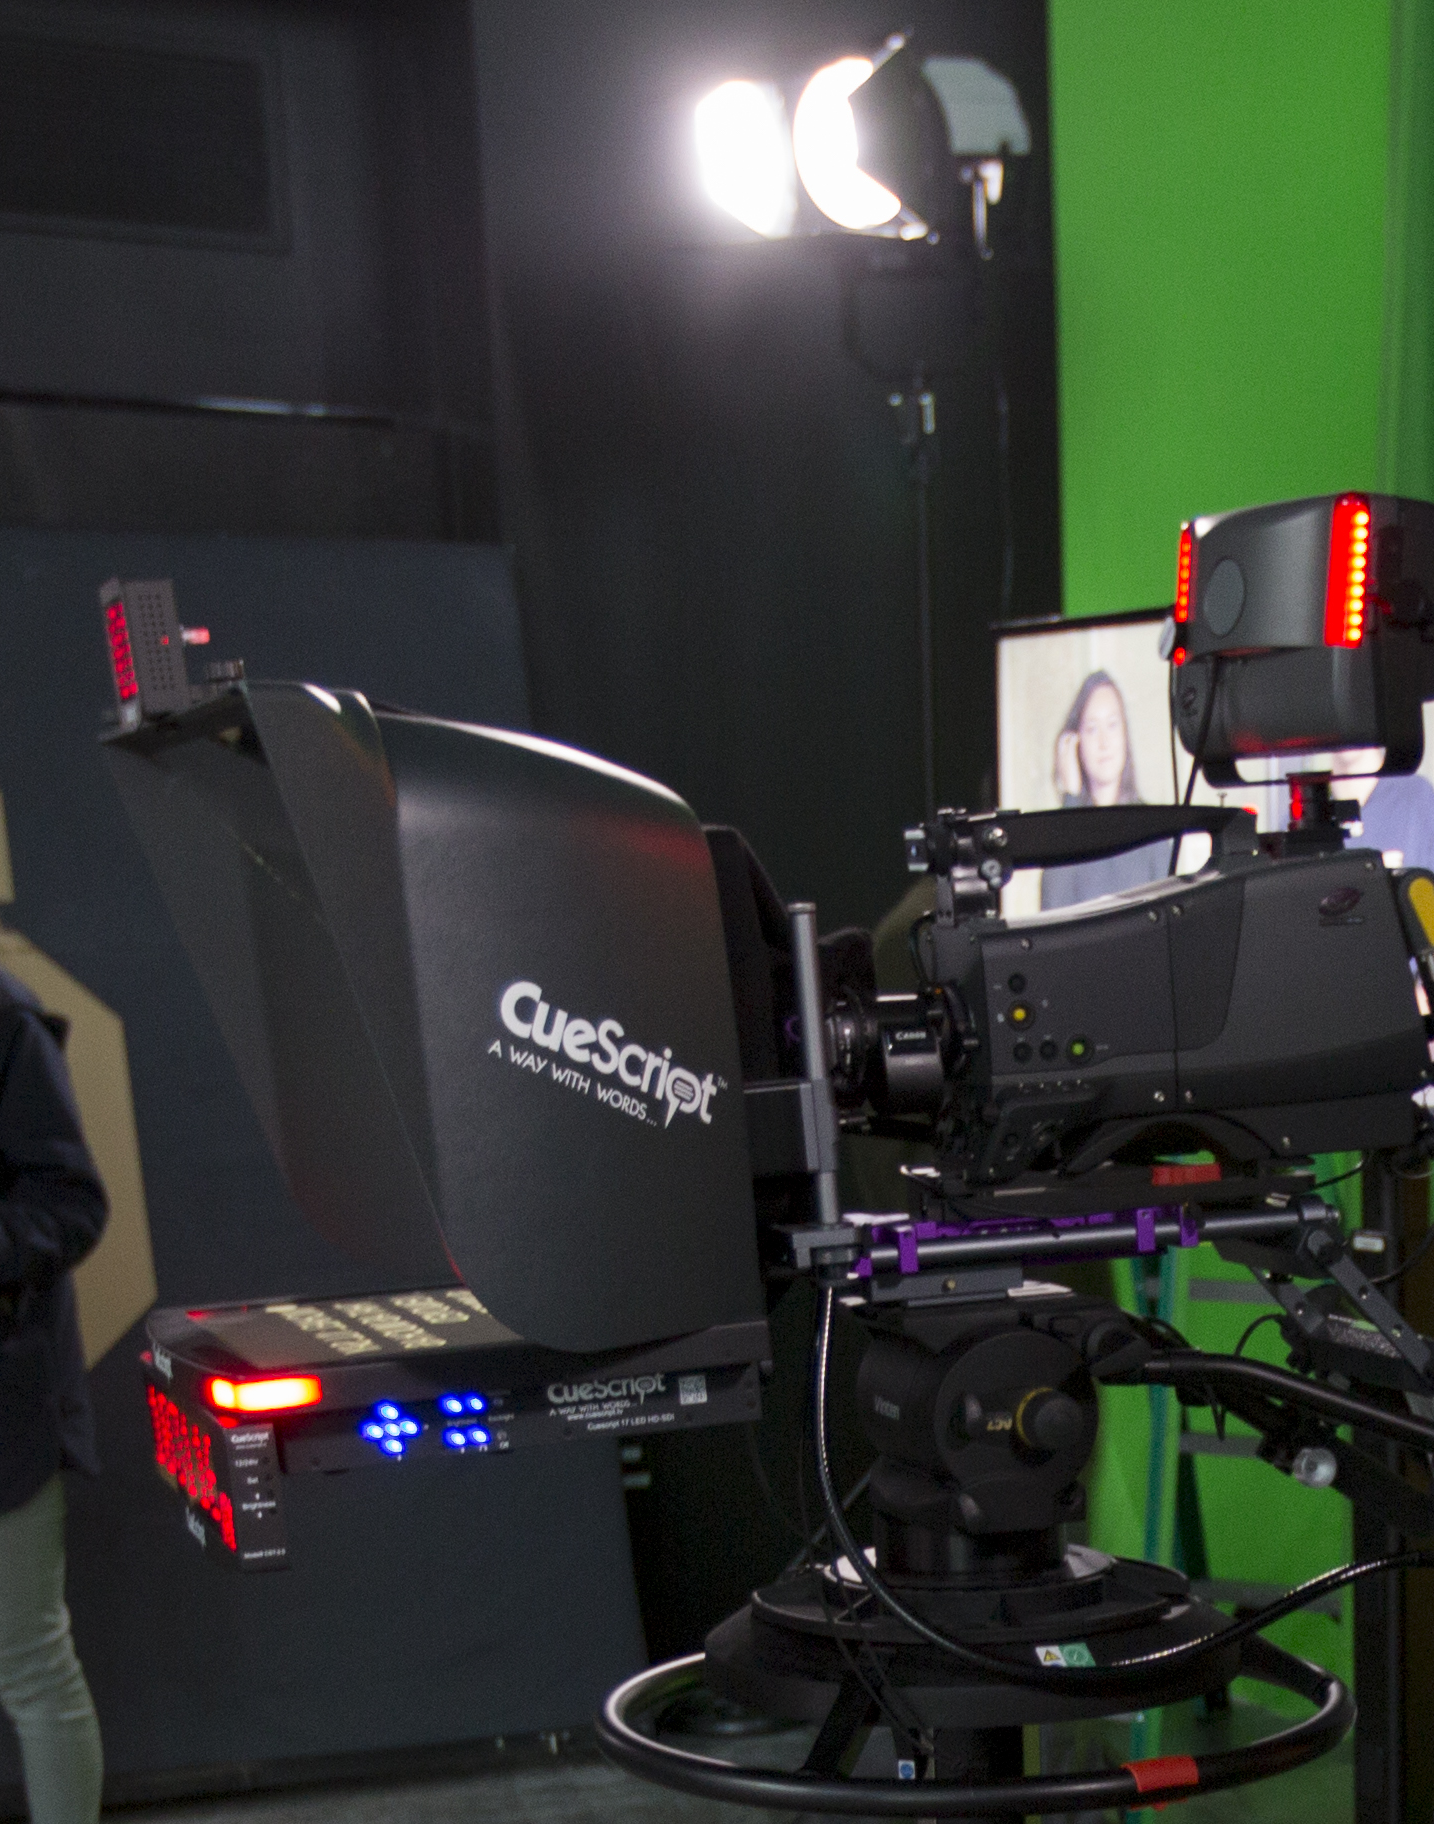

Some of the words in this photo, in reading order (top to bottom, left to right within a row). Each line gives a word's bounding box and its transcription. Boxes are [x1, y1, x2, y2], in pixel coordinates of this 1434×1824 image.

[488, 1039, 503, 1057] A
[510, 1045, 548, 1074] WAY
[552, 1063, 591, 1095] WITH
[501, 980, 717, 1129] CueScript
